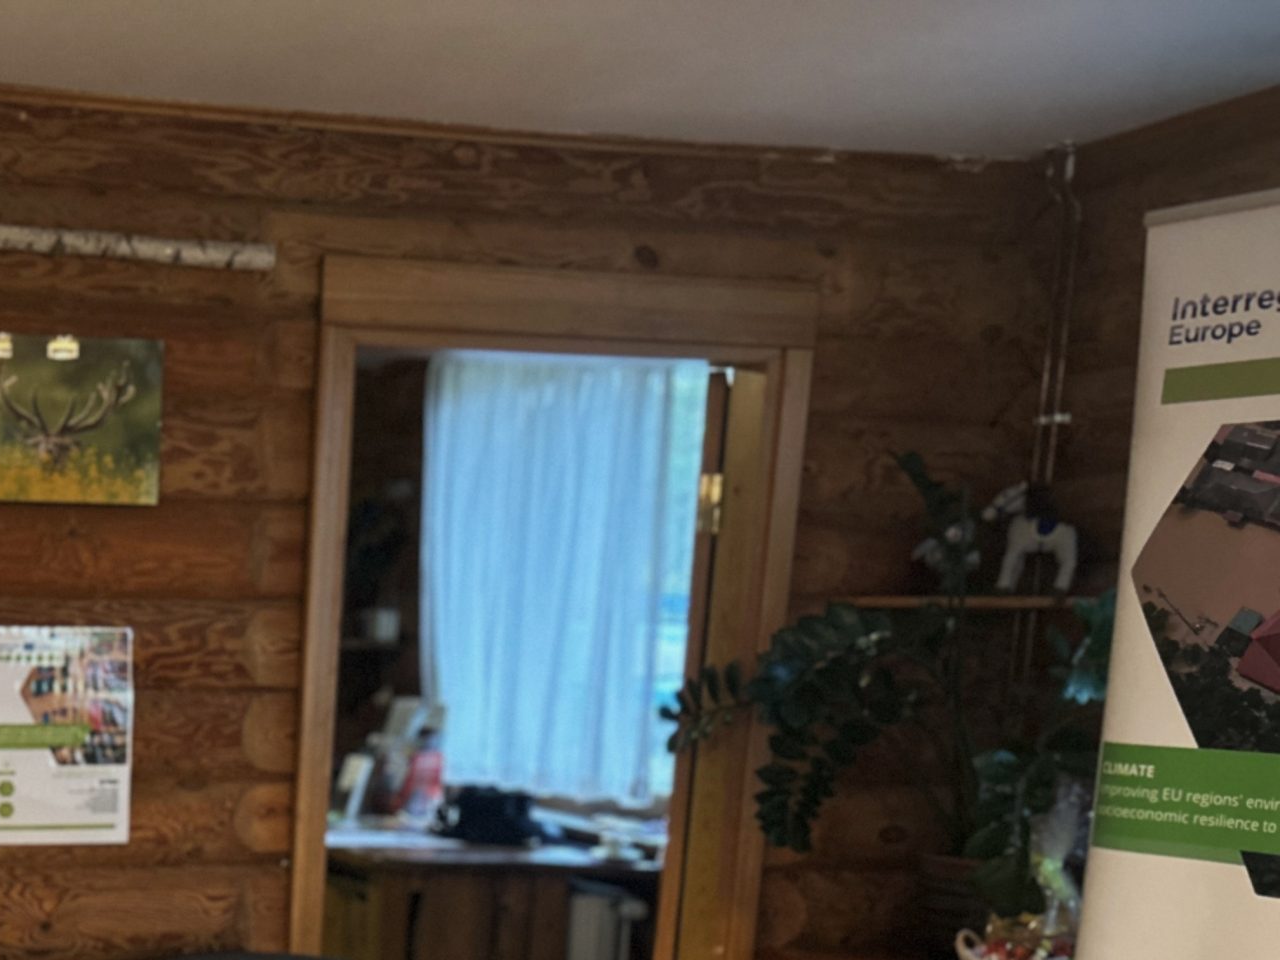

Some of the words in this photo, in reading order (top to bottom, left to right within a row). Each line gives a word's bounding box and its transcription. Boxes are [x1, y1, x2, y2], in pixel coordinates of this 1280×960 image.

[1169, 320, 1261, 345] Europe
[1162, 786, 1184, 802] EU
[1193, 814, 1260, 832] resilience
[1262, 820, 1277, 834] to
